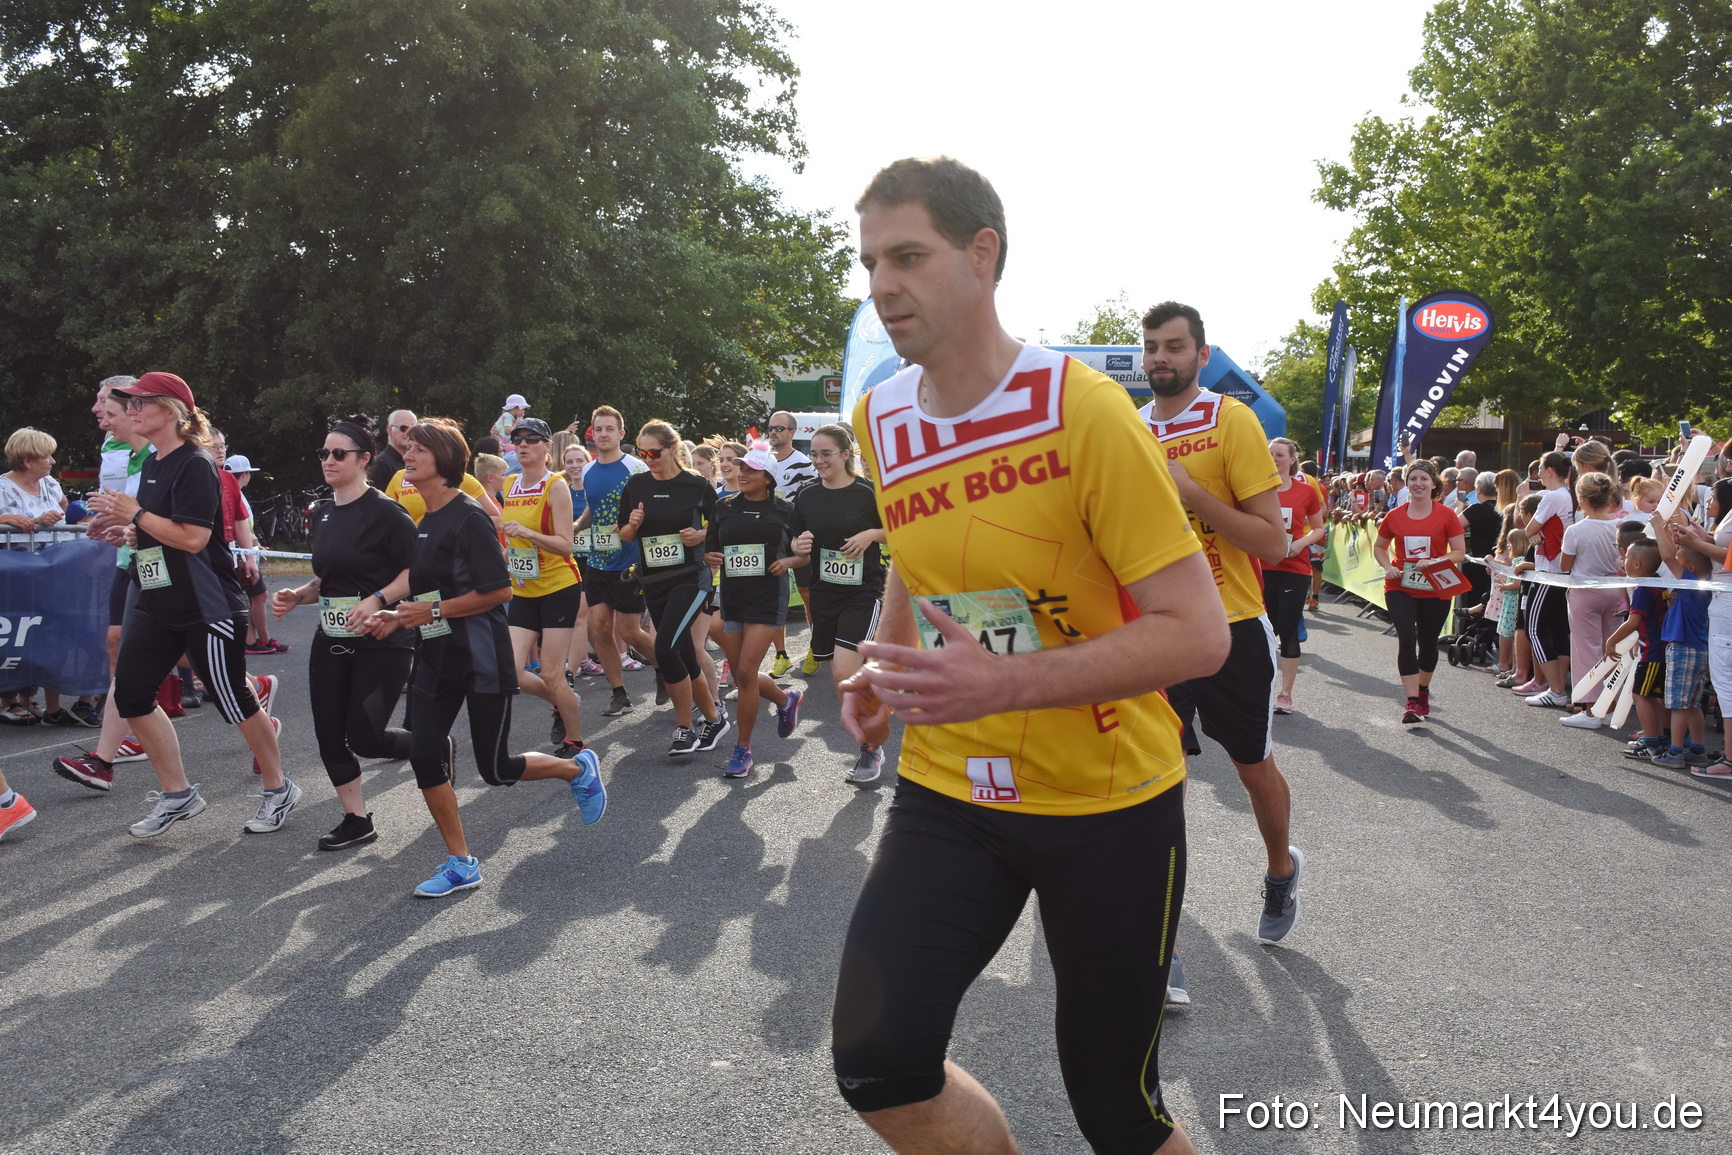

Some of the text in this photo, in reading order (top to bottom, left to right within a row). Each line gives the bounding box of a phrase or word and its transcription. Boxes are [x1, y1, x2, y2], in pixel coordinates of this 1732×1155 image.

[1421, 309, 1482, 332] Hervis
[1167, 436, 1218, 460] BÖGL
[884, 449, 1070, 533] MAX BÖGL
[522, 497, 539, 506] BÖG
[573, 536, 585, 546] 65
[596, 534, 612, 545] 257
[648, 545, 679, 559] 1982
[510, 558, 533, 571] 1625
[729, 555, 759, 568] 1989
[824, 561, 855, 576] 2001
[140, 562, 159, 579] 997
